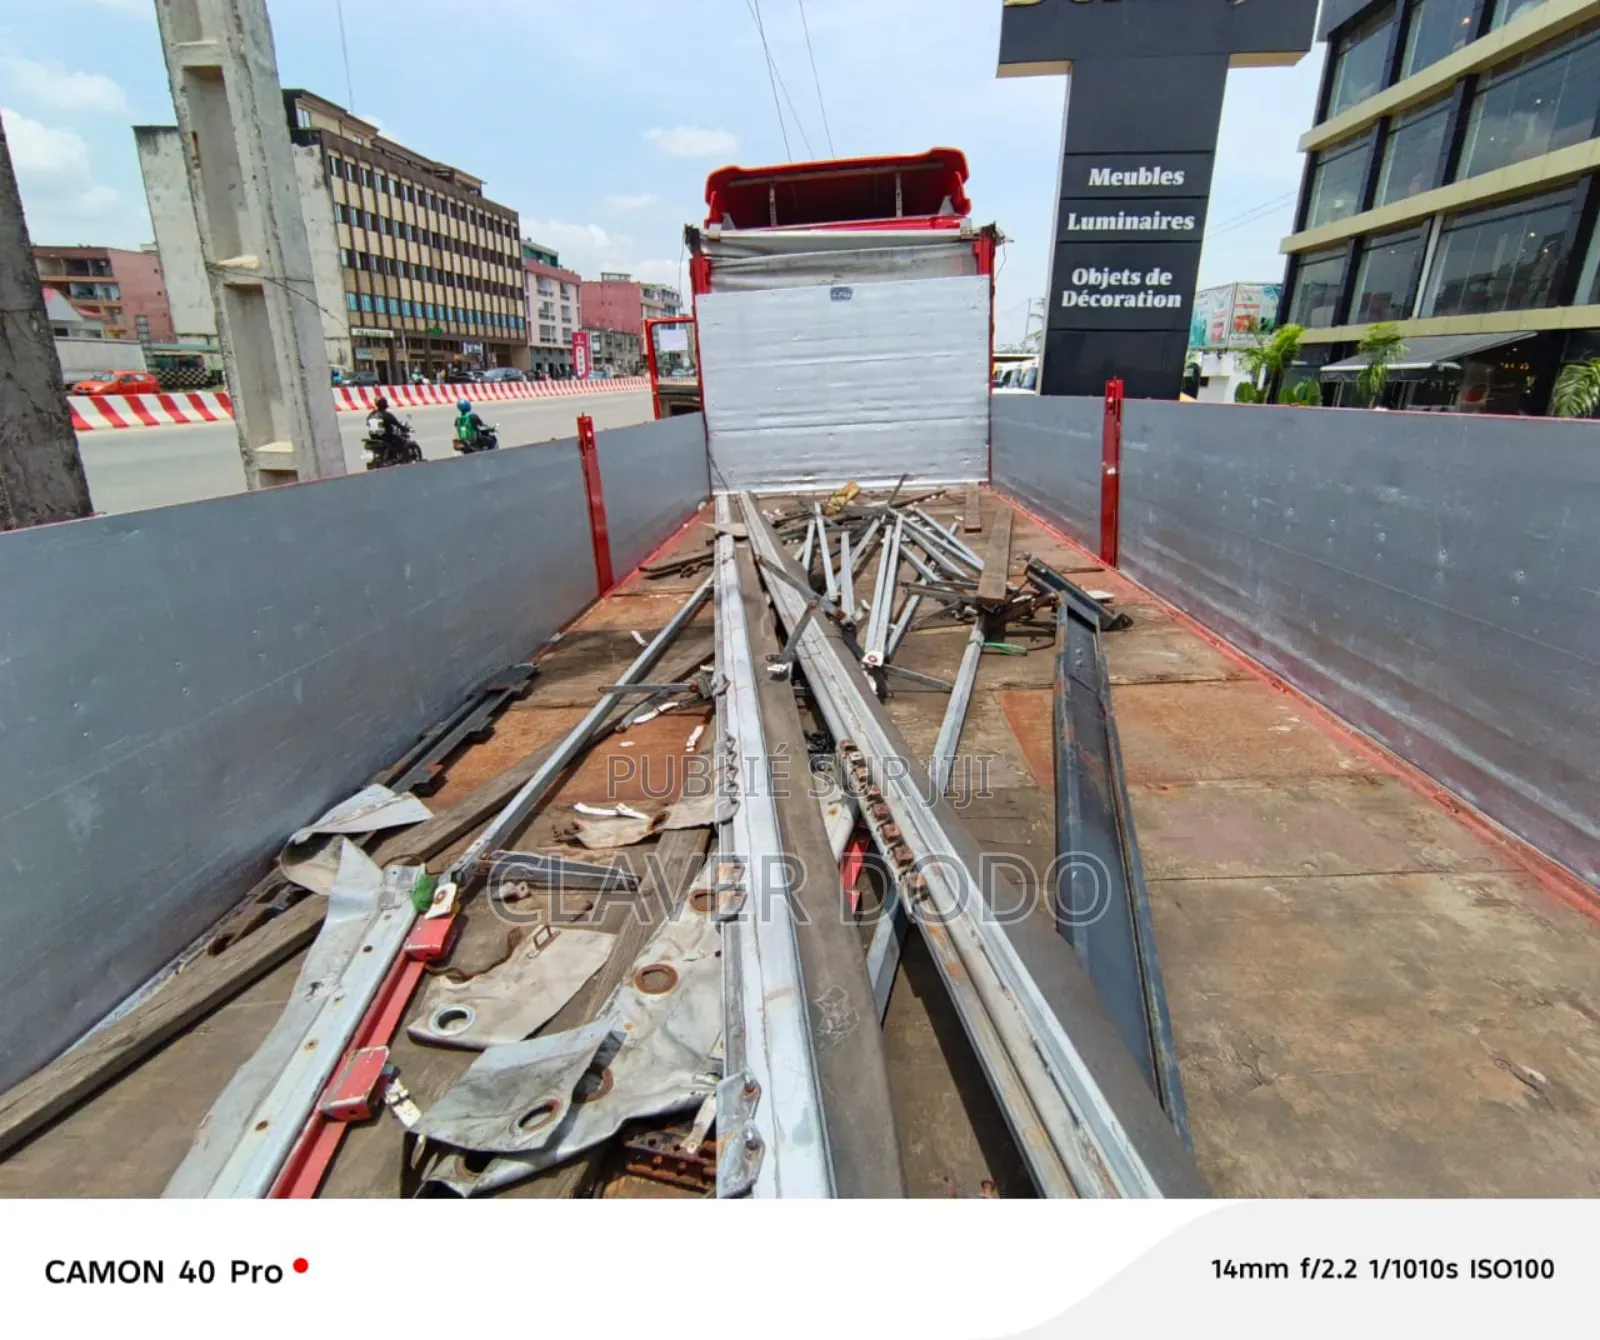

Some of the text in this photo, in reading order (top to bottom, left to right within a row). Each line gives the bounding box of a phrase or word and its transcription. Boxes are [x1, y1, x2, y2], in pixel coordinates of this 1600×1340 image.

[1088, 166, 1185, 186] Meubles
[1067, 211, 1195, 231] Luminaires
[1071, 267, 1173, 290] Objets de
[1061, 289, 1182, 308] Décoration
